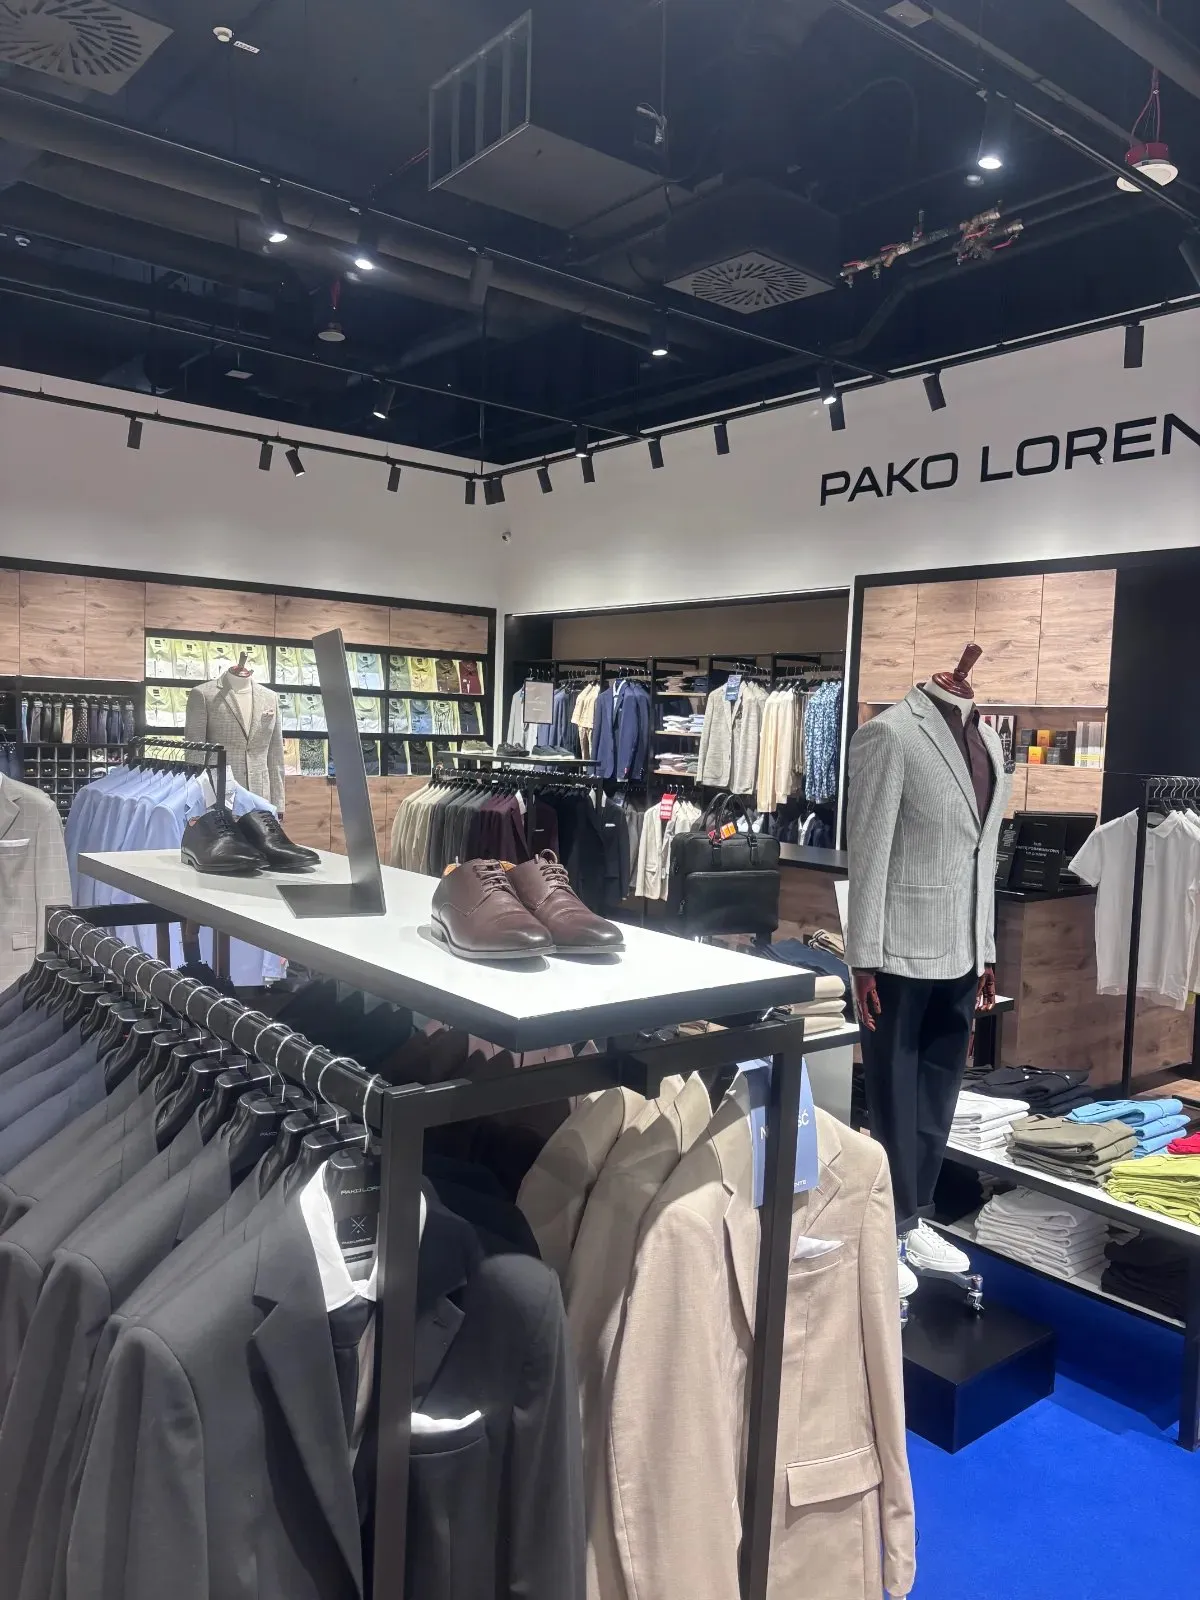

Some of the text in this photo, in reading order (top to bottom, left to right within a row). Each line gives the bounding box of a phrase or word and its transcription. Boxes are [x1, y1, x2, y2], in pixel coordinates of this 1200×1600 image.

[820, 413, 1200, 506] PAKO LOREN
[340, 1188, 361, 1196] PAKO
